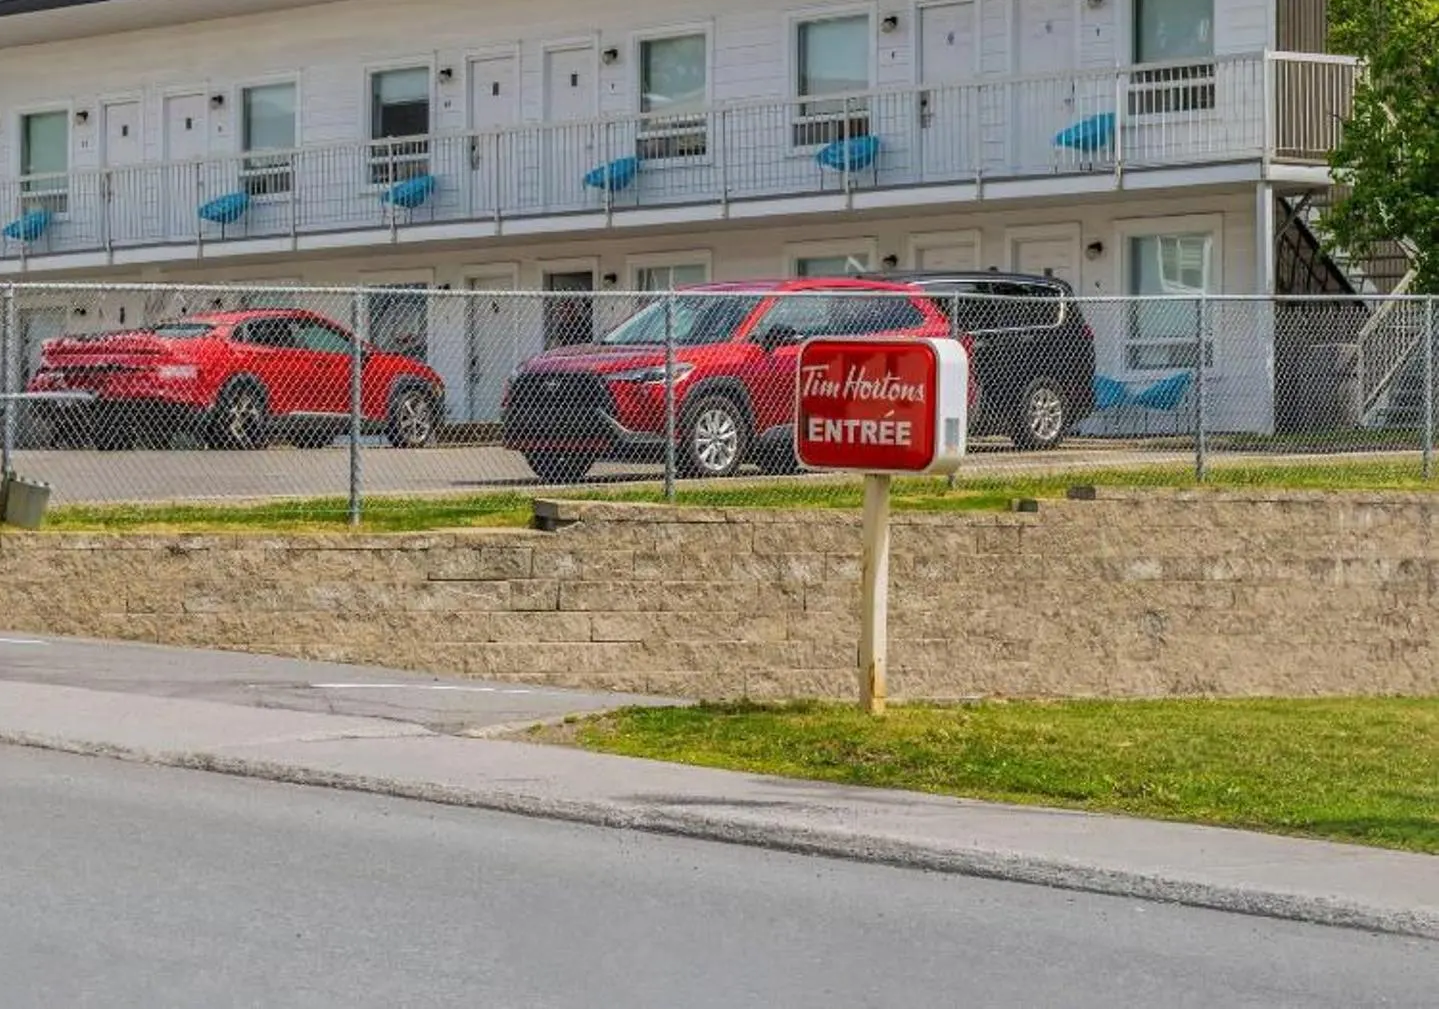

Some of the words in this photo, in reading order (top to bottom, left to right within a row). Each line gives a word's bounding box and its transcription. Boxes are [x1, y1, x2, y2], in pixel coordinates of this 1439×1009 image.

[801, 363, 840, 398] Tim
[843, 363, 926, 404] Hortons
[809, 410, 913, 446] ENTRÉE
